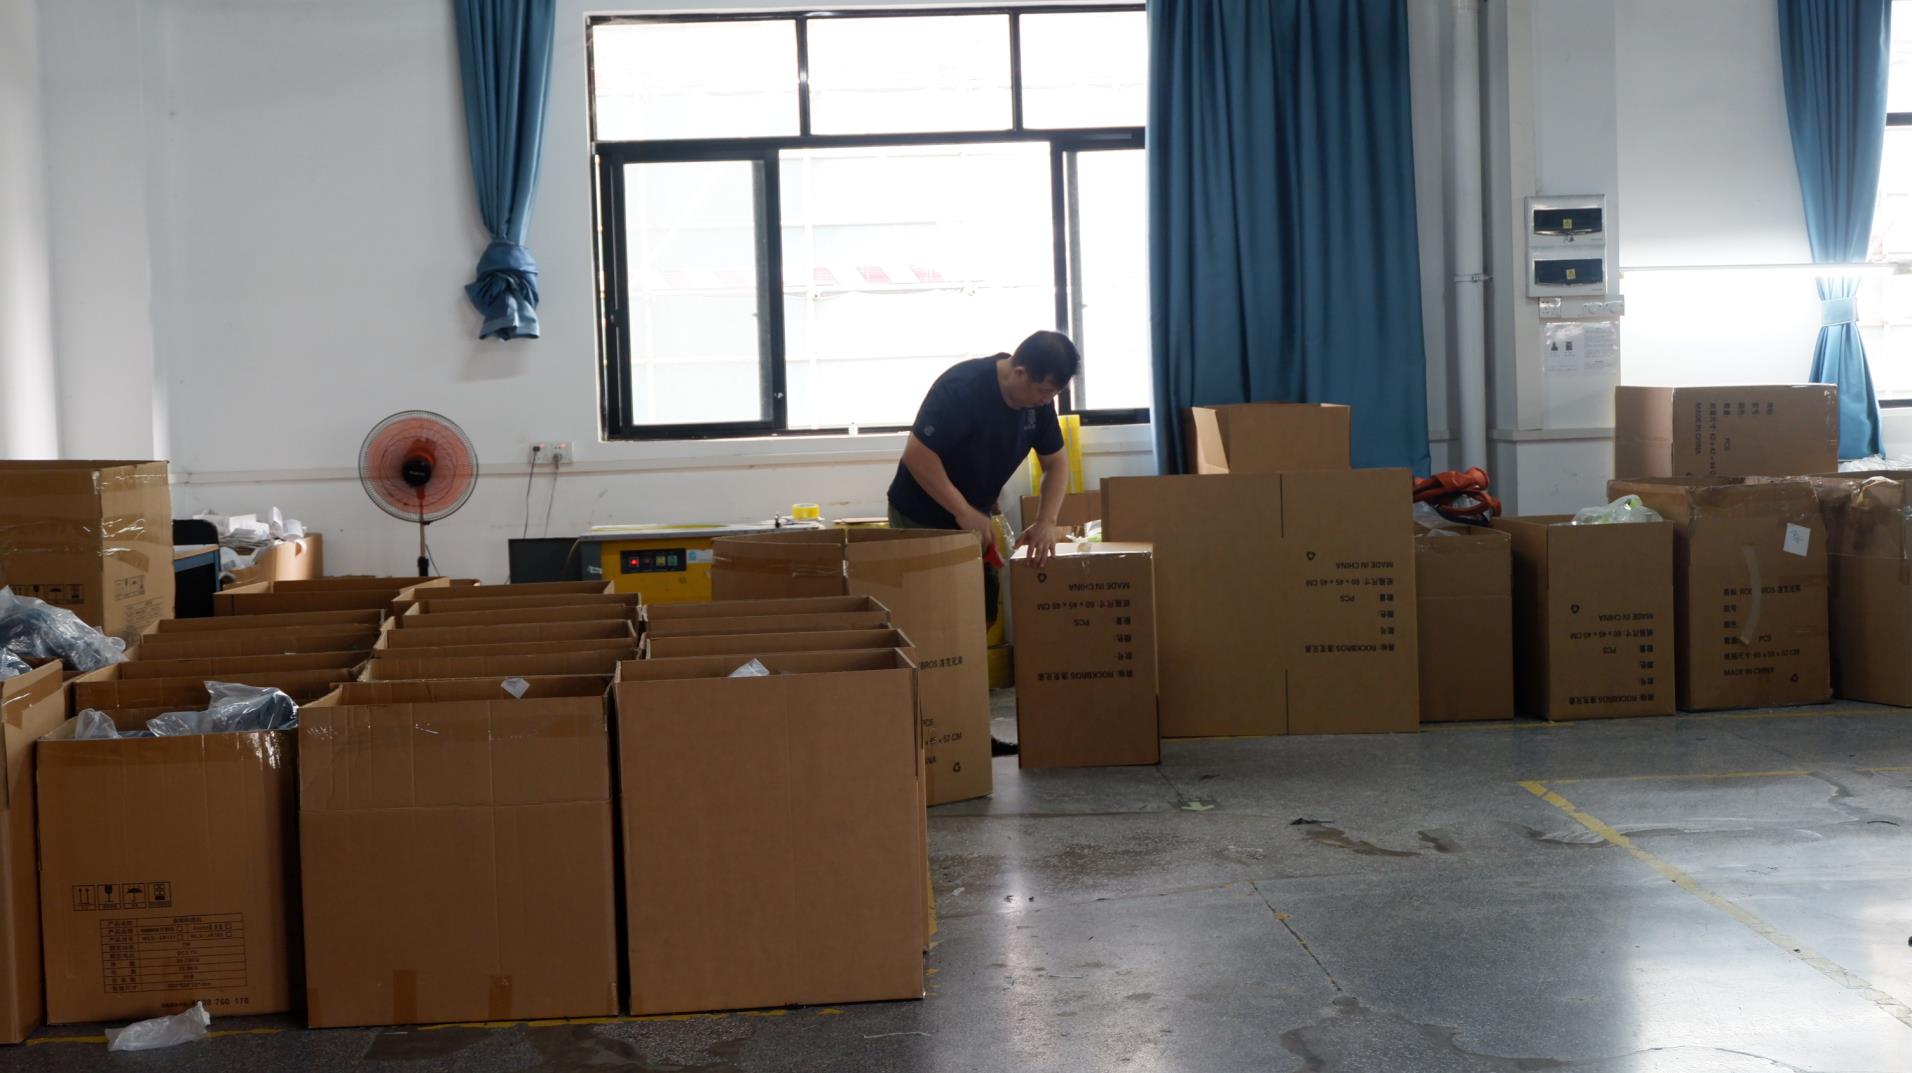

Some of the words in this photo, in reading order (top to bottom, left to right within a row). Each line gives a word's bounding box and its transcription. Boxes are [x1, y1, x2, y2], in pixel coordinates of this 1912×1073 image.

[1360, 561, 1369, 569] IN
[1371, 561, 1394, 569] MADE
[1068, 584, 1094, 592] CHINA
[1095, 583, 1105, 591] IN
[1106, 582, 1130, 590] MADE
[1598, 614, 1622, 622] CHINA
[1602, 646, 1617, 654] PCS
[1071, 671, 1114, 680] ROCKBROS
[1723, 668, 1744, 676] MADE
